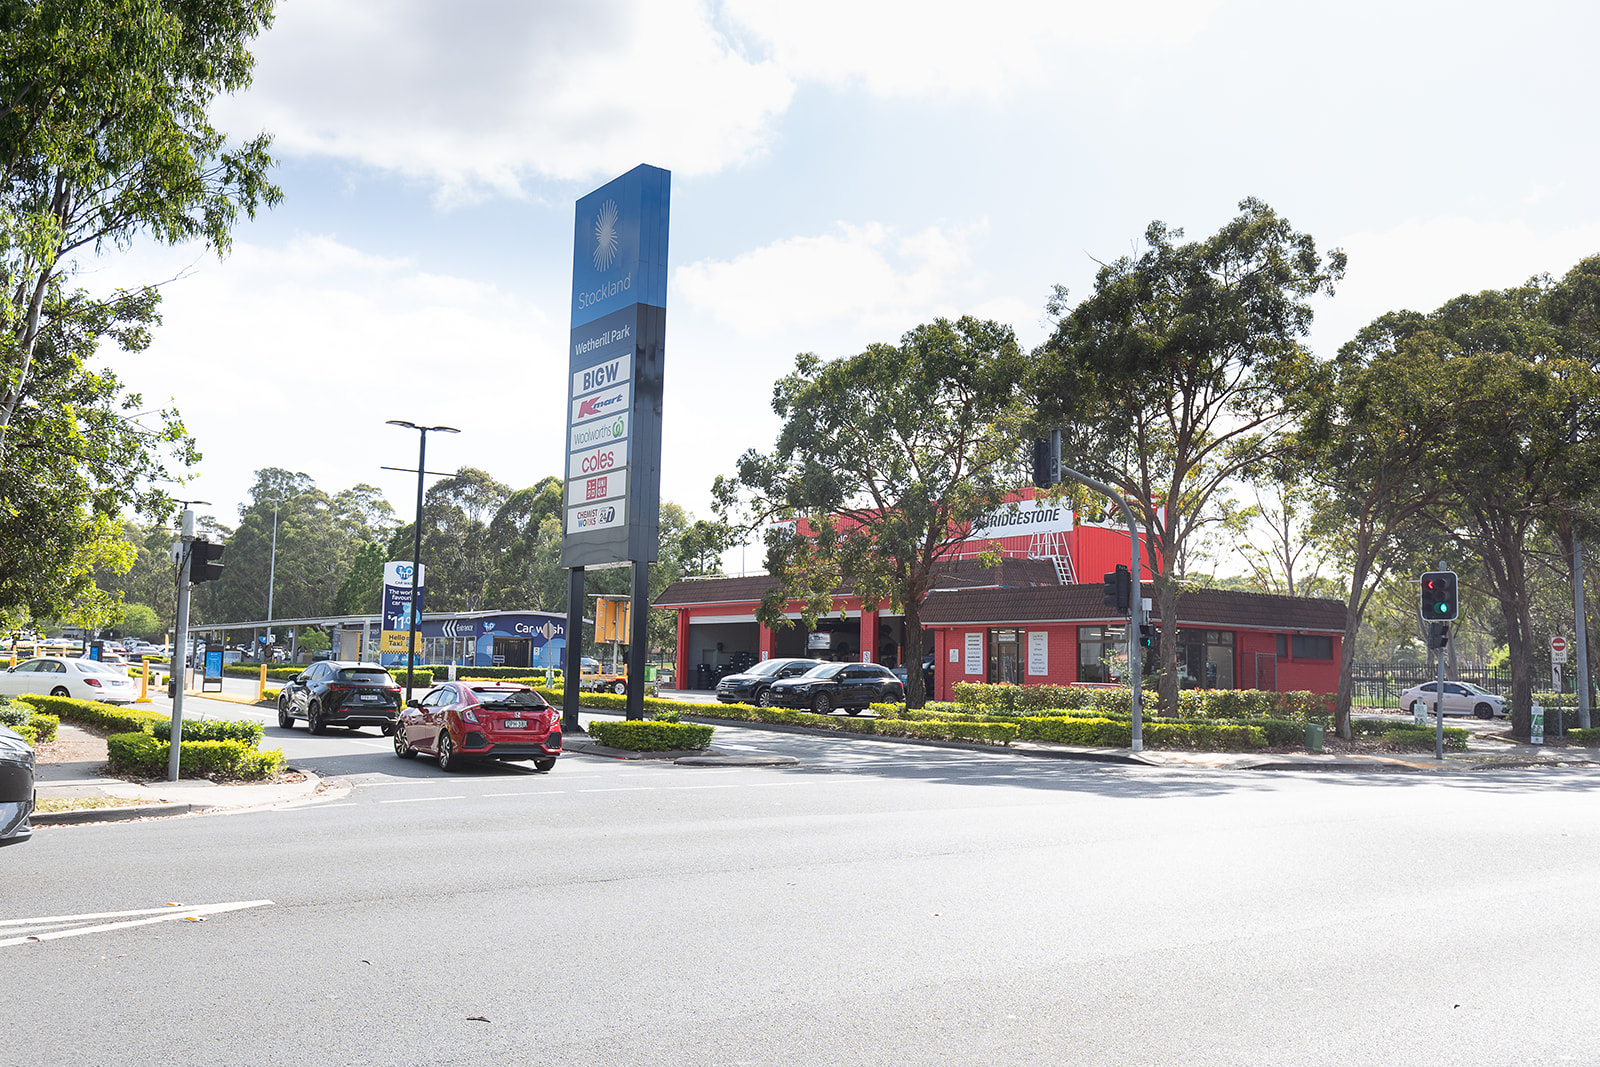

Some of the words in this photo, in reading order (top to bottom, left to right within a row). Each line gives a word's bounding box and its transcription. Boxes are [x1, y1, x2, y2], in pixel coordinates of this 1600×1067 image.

[578, 272, 631, 310] Stockland
[575, 331, 610, 356] Wetherill
[611, 324, 631, 343] Park
[578, 394, 623, 419] Kmart
[574, 423, 612, 445] Woolworths
[582, 450, 614, 473] coles
[577, 509, 598, 519] CHEMIST
[578, 518, 597, 528] WORKS
[515, 623, 535, 633] Car
[536, 622, 564, 634] wsh
